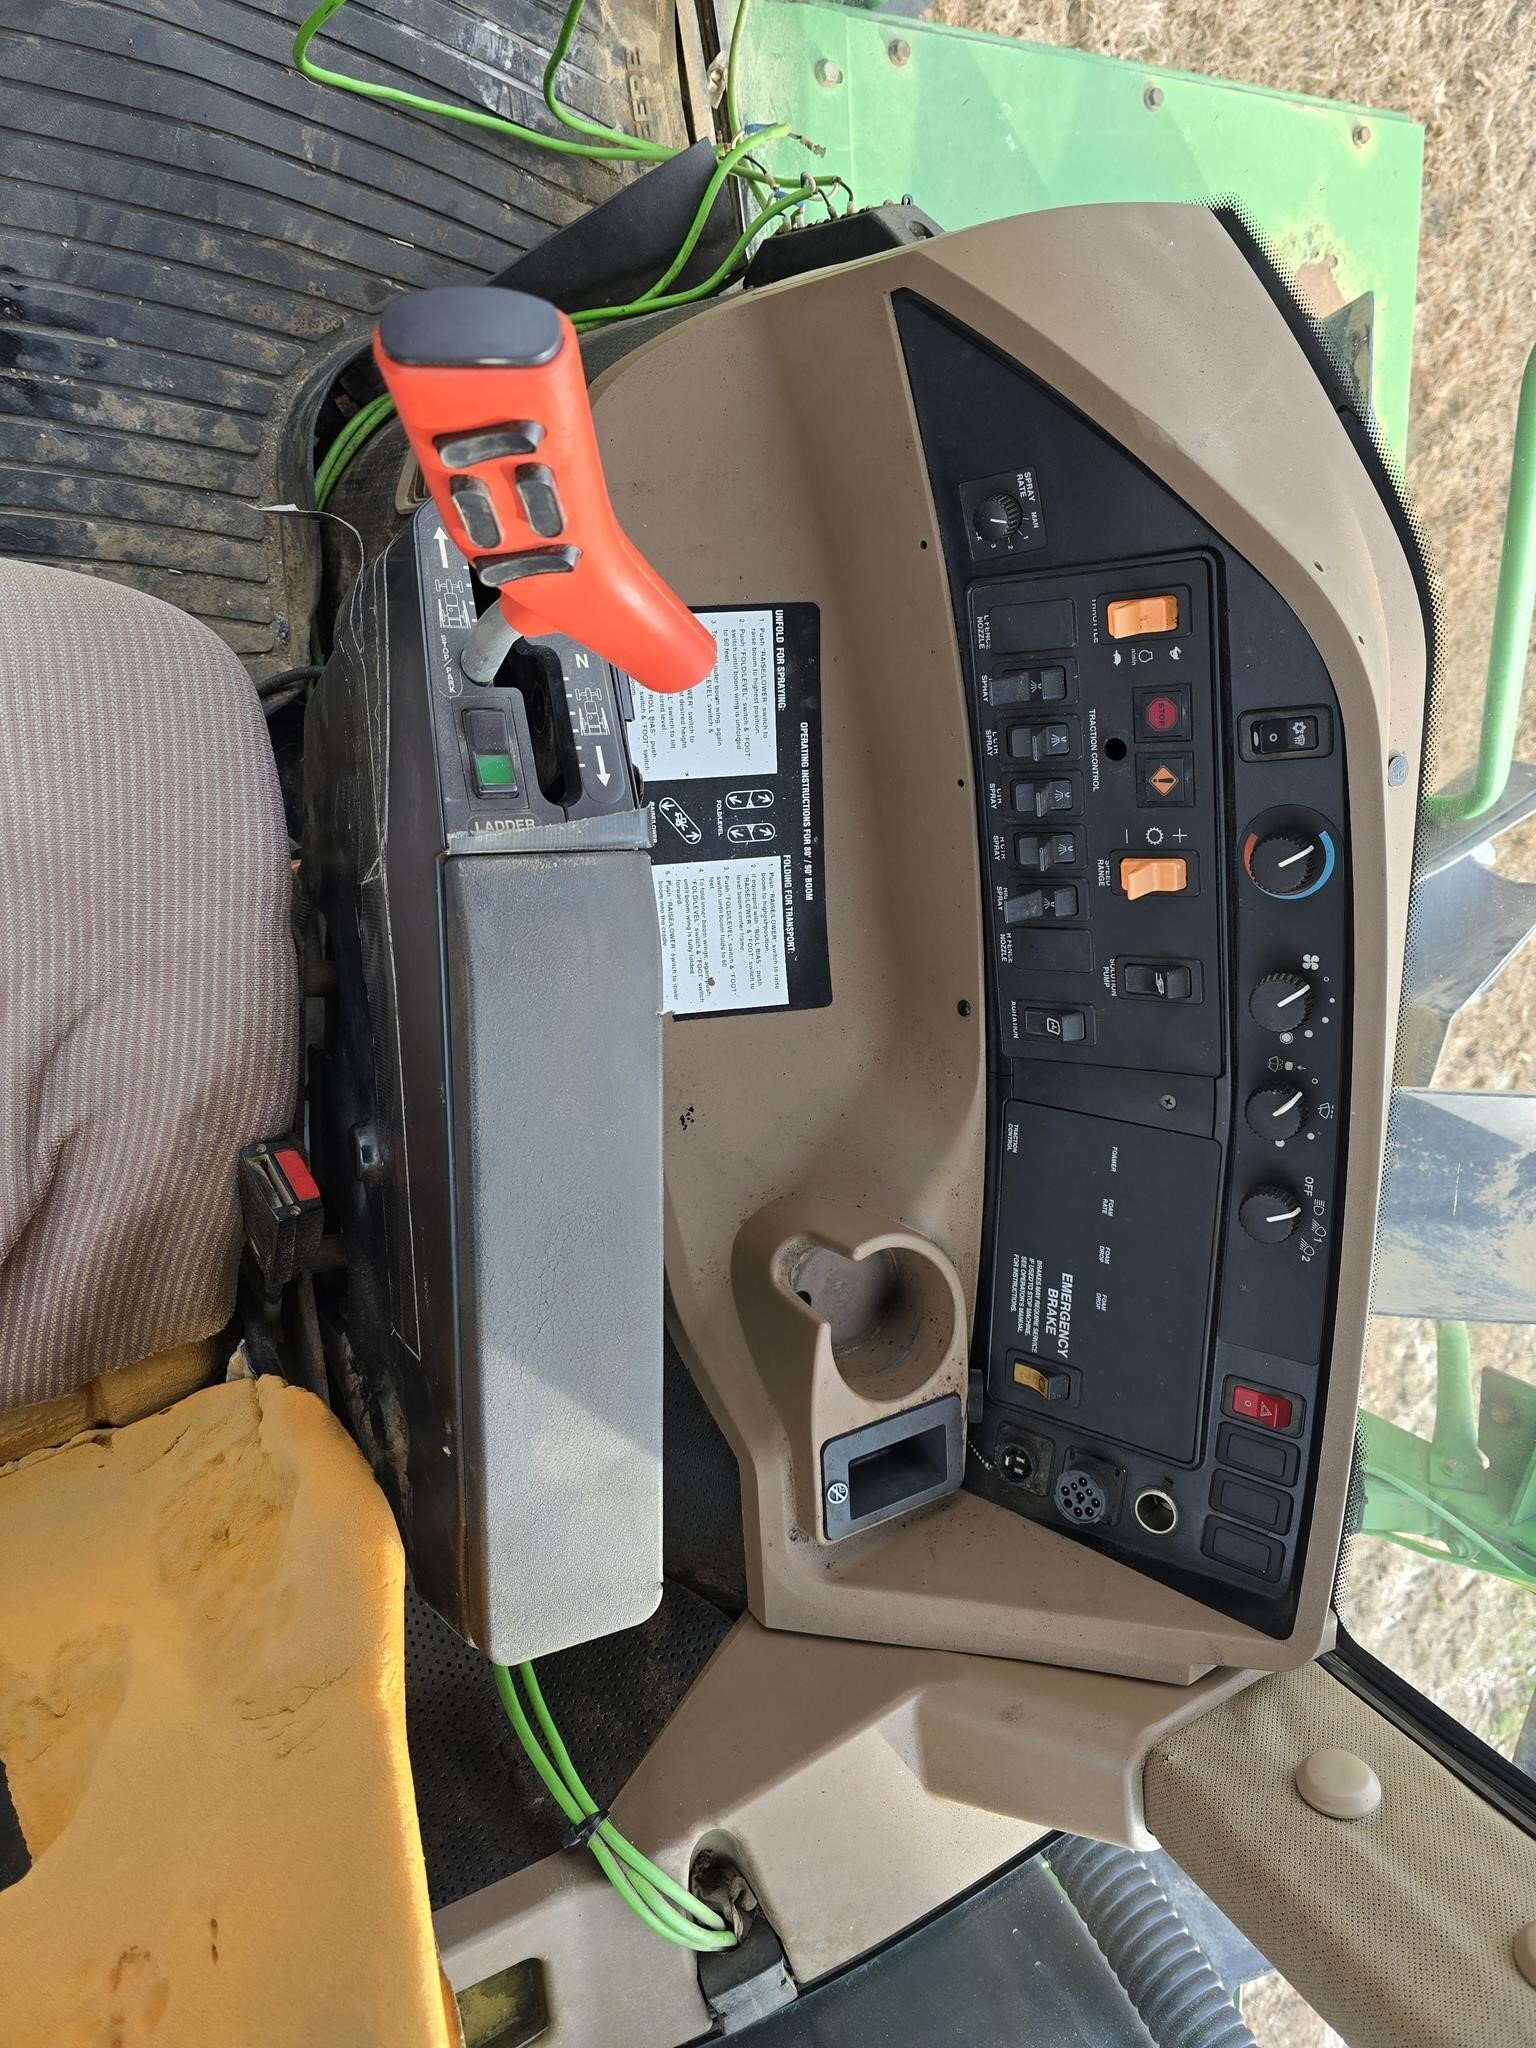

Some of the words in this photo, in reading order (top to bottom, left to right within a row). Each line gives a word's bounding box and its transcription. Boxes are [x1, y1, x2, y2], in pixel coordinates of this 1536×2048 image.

[624, 47, 651, 138] EERE
[1017, 474, 1027, 498] RATE
[1024, 472, 1036, 501] SPRAY
[1031, 512, 1039, 528] MAN
[724, 638, 729, 646] 60
[775, 610, 783, 642] UNFOLD
[977, 617, 985, 649] NOZZLE
[440, 634, 456, 693] STOP/PARK
[576, 654, 589, 668] N
[776, 648, 784, 665] FOR
[752, 678, 760, 704] highest
[760, 648, 768, 706] "RAISE/LOWER"
[777, 667, 786, 711] SPRAYING:
[800, 722, 809, 768] OPERATING
[1088, 709, 1097, 750] TRACTION
[1090, 752, 1100, 792] CONTROL
[801, 769, 810, 827] INSTRUCTIONS
[989, 783, 997, 809] SPRAY
[803, 829, 811, 844] FOR
[803, 846, 812, 858] 80'
[783, 854, 792, 888] FOLDING
[804, 863, 812, 876] 90'
[1098, 860, 1106, 886] RANGE
[784, 890, 792, 905] FOR
[804, 878, 813, 900] BOOM
[786, 906, 794, 954] TRANSPORT:
[1109, 958, 1117, 996] SOLUTION
[1303, 1176, 1314, 1196] OFF
[1010, 1268, 1018, 1312] INSTRUCTIONS.
[1018, 1269, 1026, 1307] OPERATOR'S
[1046, 1288, 1058, 1335] BRAKE
[1058, 1273, 1073, 1358] EMERGENCY
